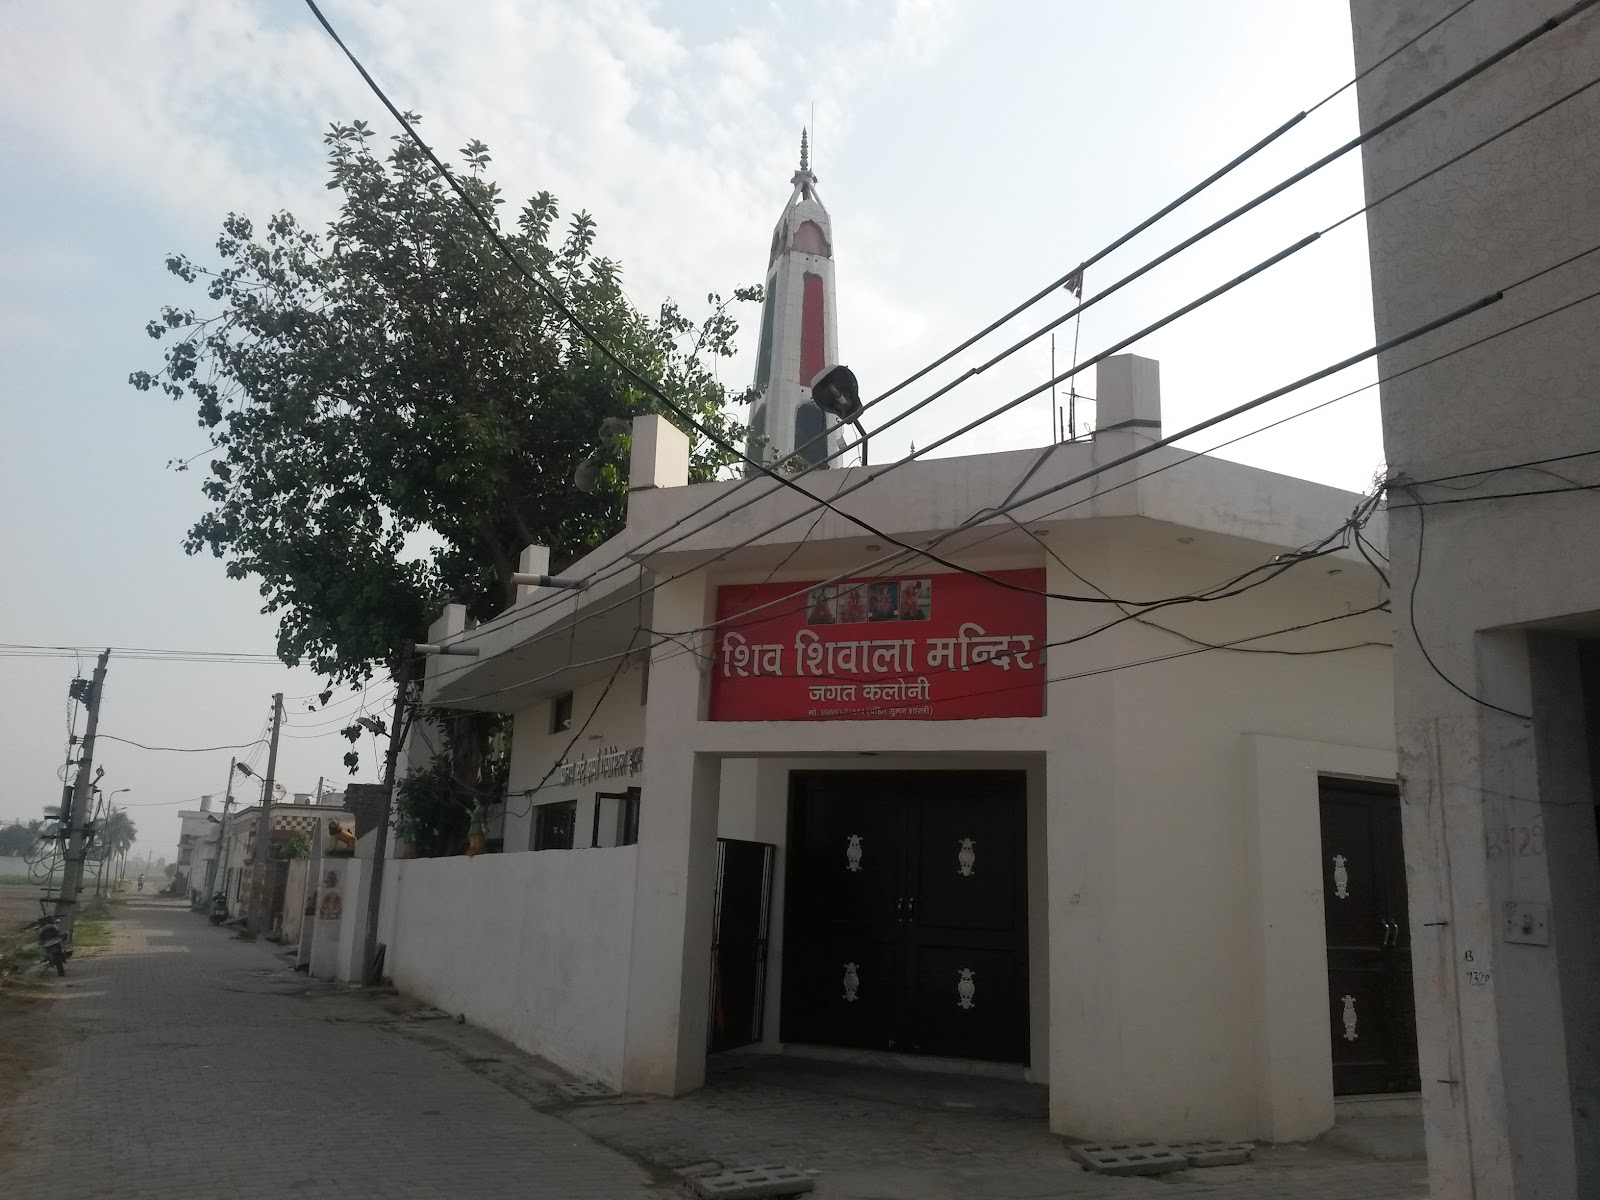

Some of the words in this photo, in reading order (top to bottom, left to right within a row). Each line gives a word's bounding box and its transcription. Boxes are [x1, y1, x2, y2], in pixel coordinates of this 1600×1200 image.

[722, 631, 784, 677] शिव
[794, 629, 915, 676] शिवाला
[926, 622, 1034, 672] मन्दिर
[808, 684, 857, 702] जगत
[862, 676, 931, 701] कलोनी
[1465, 950, 1474, 962] B
